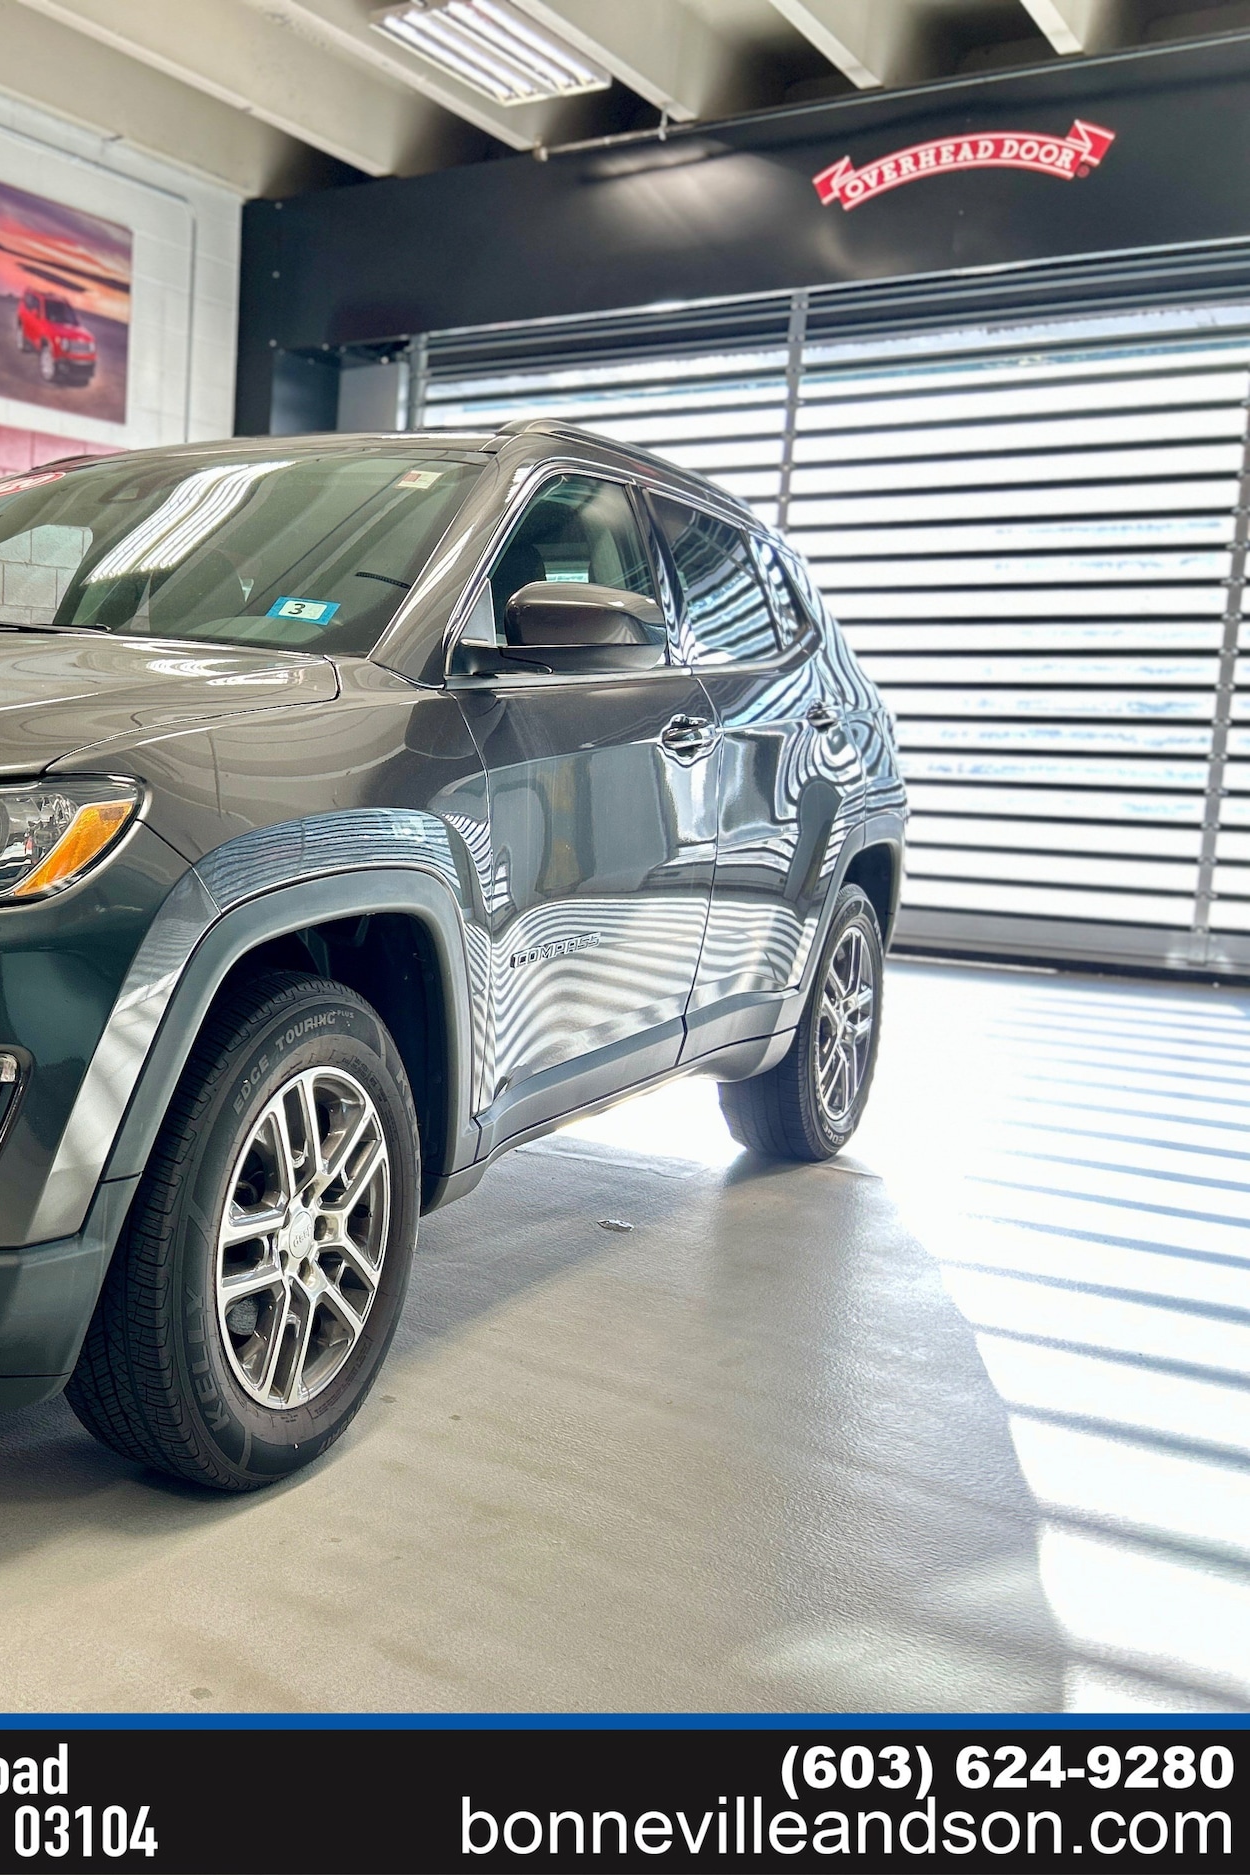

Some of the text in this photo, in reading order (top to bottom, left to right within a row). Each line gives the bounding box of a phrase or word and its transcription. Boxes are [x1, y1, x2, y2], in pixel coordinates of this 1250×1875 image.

[845, 139, 1074, 198] OVERHEAD DOOR
[287, 603, 306, 615] 3
[510, 931, 601, 968] COMPASS
[232, 1054, 271, 1116] EDGE
[274, 1012, 337, 1053] TOURING
[185, 1284, 230, 1432] KELLY
